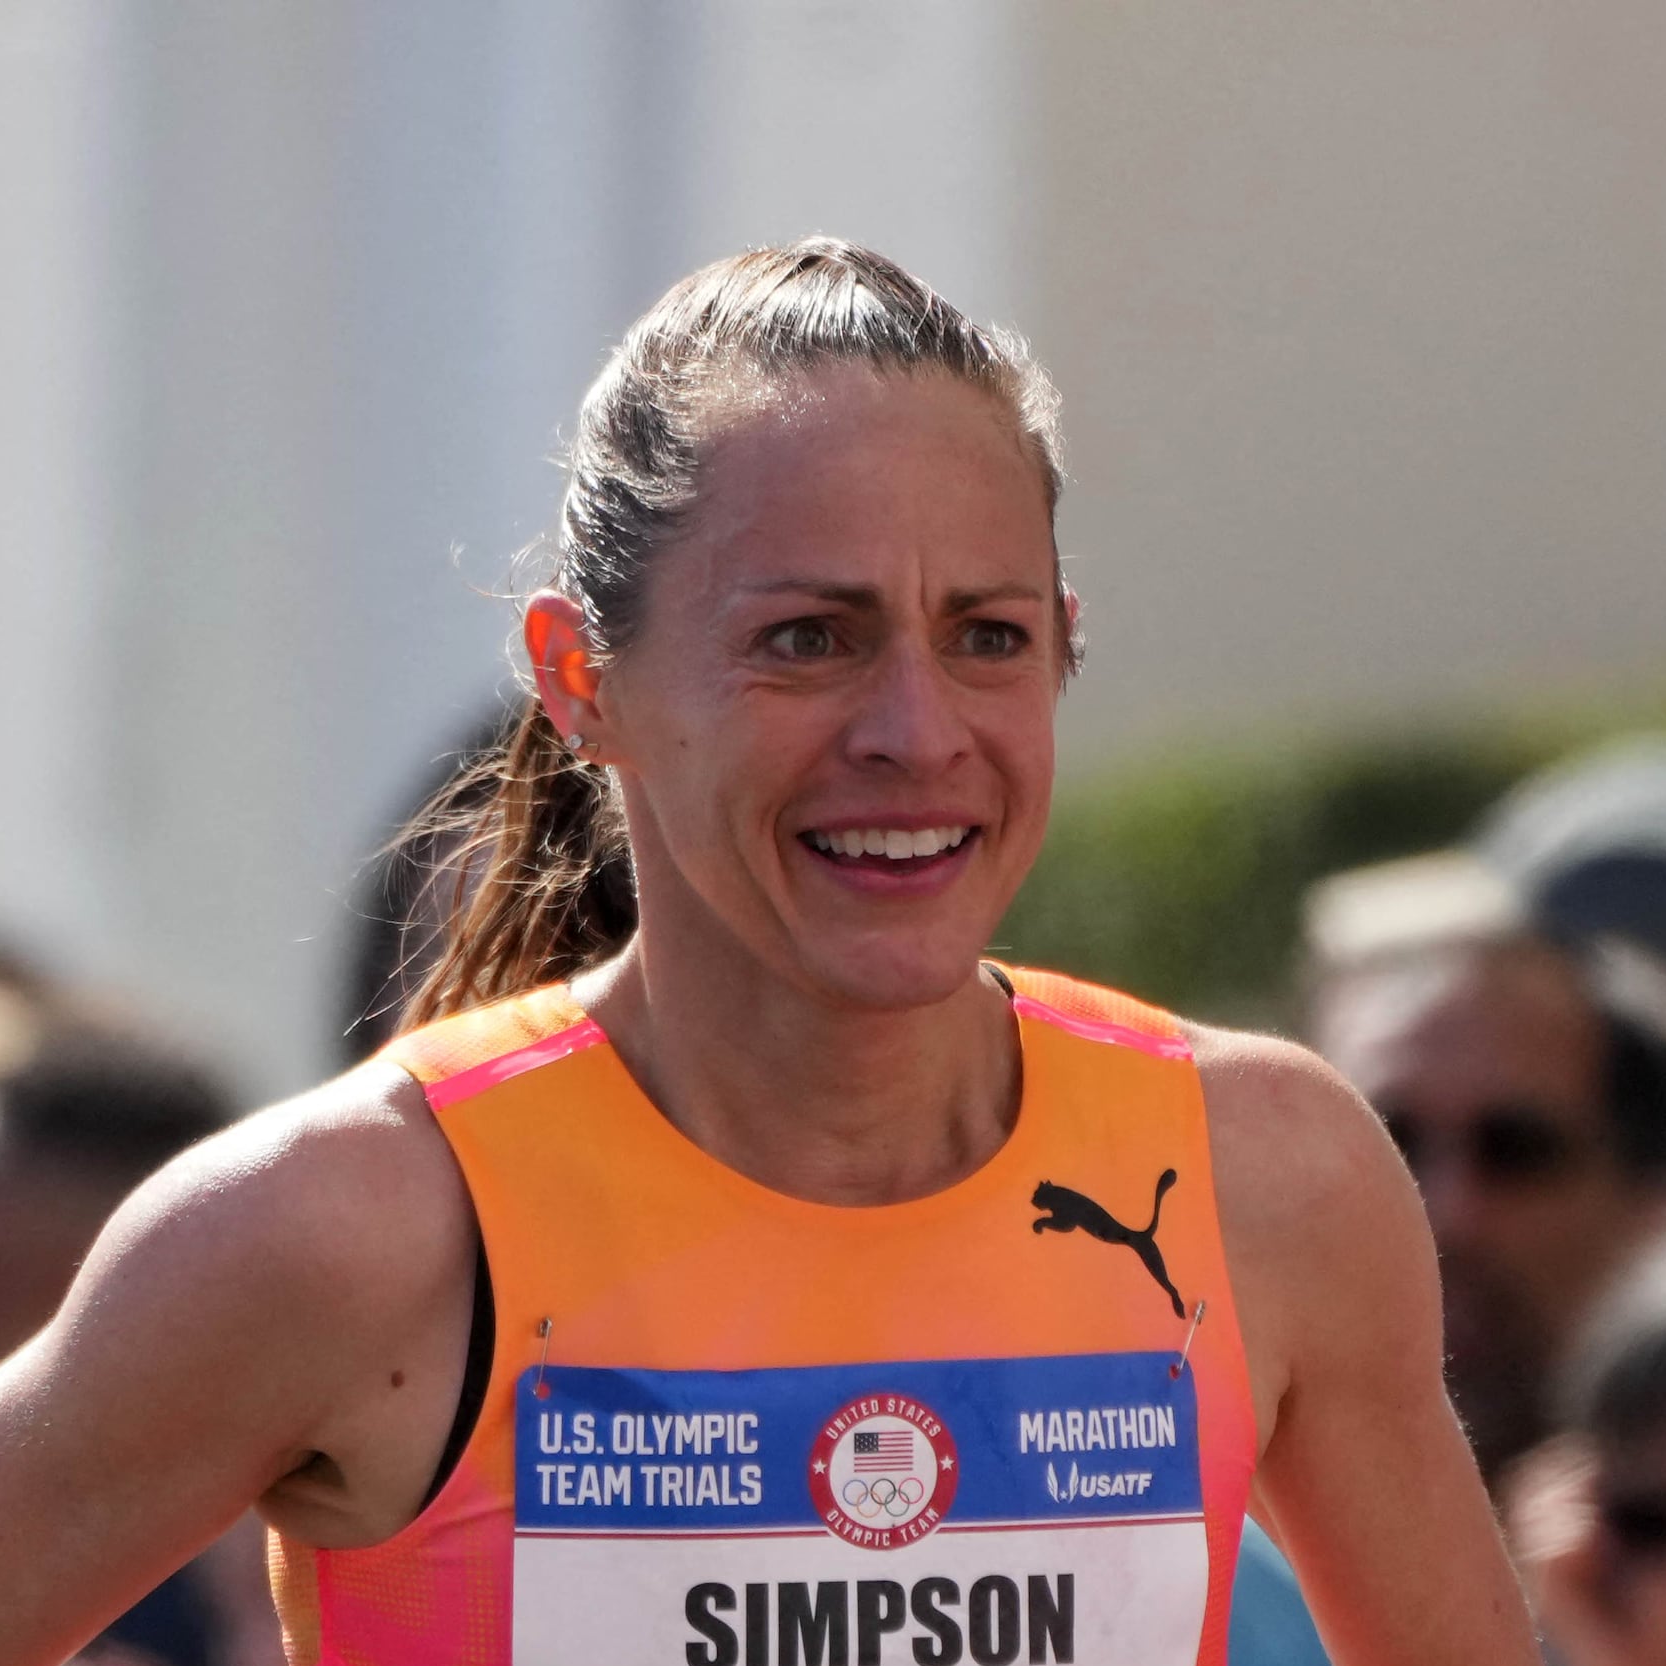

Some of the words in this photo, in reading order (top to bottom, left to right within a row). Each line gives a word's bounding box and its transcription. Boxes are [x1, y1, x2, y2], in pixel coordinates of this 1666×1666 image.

[539, 1412, 605, 1455] U.S.
[612, 1413, 759, 1456] OLYMPIC
[826, 1399, 880, 1440] UNITED
[887, 1398, 942, 1437] STATES
[1019, 1406, 1176, 1455] MARATHON
[536, 1464, 632, 1506] TEAM
[640, 1464, 763, 1507] TRIALS
[1080, 1472, 1154, 1498] USATF
[826, 1509, 891, 1547] OLYMPIC
[900, 1508, 940, 1542] TEAM
